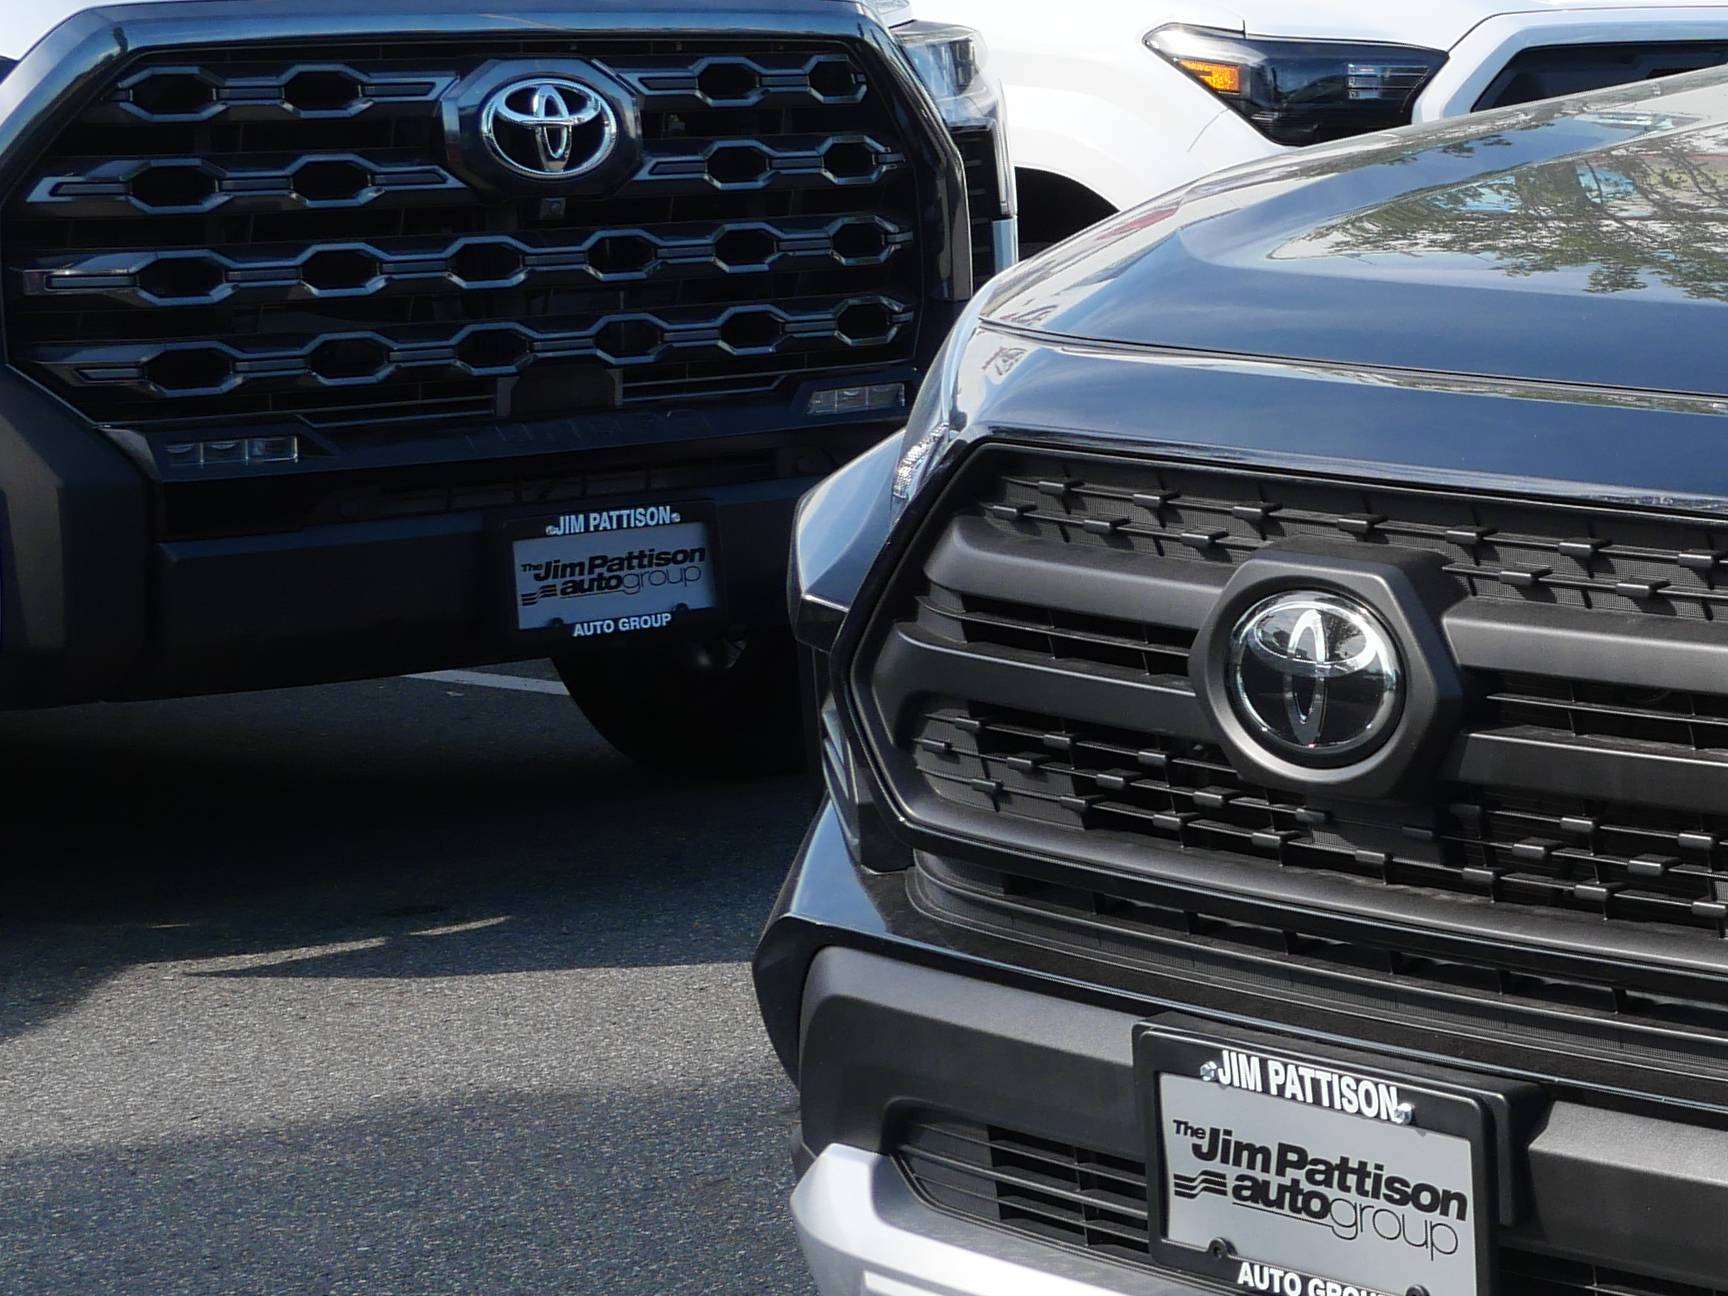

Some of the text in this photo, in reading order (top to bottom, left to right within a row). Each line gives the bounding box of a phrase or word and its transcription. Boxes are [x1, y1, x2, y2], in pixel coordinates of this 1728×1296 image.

[555, 505, 671, 536] JIM PATTISON
[520, 562, 544, 573] The
[572, 612, 672, 638] AUTO GROUP
[1217, 1050, 1400, 1122] JIM PATTISON
[1172, 1119, 1207, 1142] The
